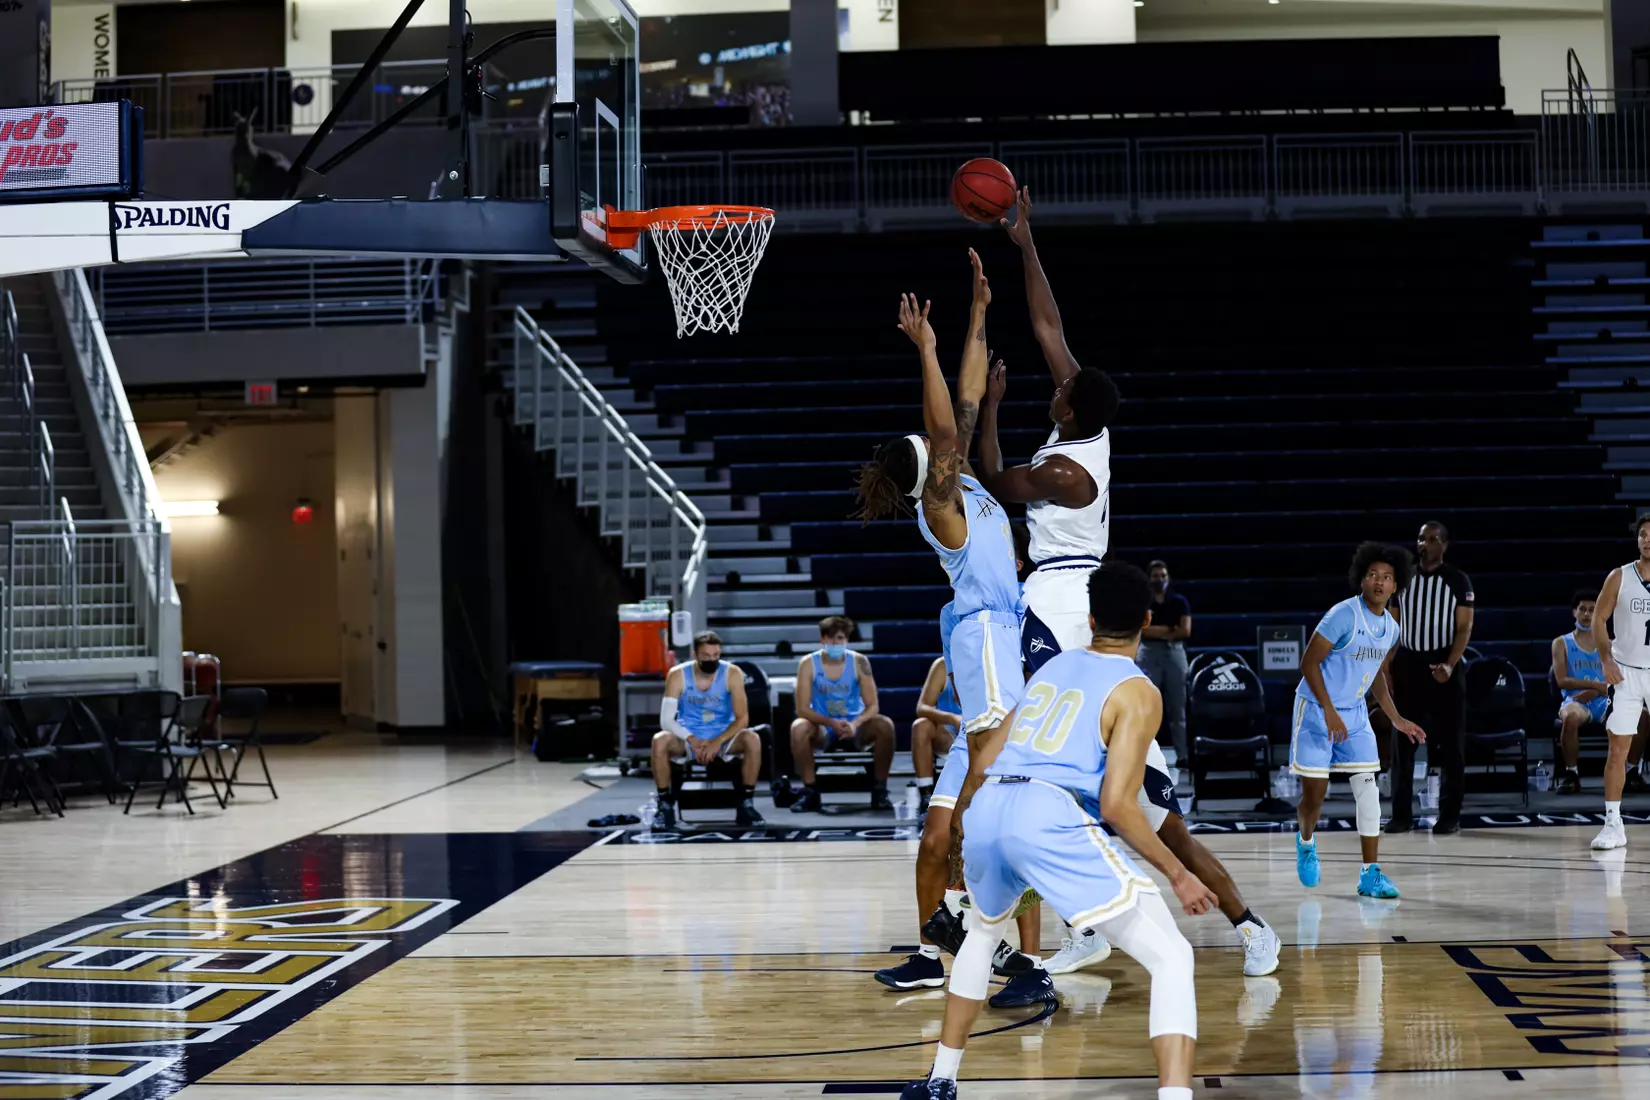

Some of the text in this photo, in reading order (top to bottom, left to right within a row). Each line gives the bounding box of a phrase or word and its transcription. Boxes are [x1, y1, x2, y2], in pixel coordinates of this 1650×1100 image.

[95, 13, 110, 79] WOME
[1008, 681, 1084, 755] 20
[1207, 681, 1246, 692] adidas
